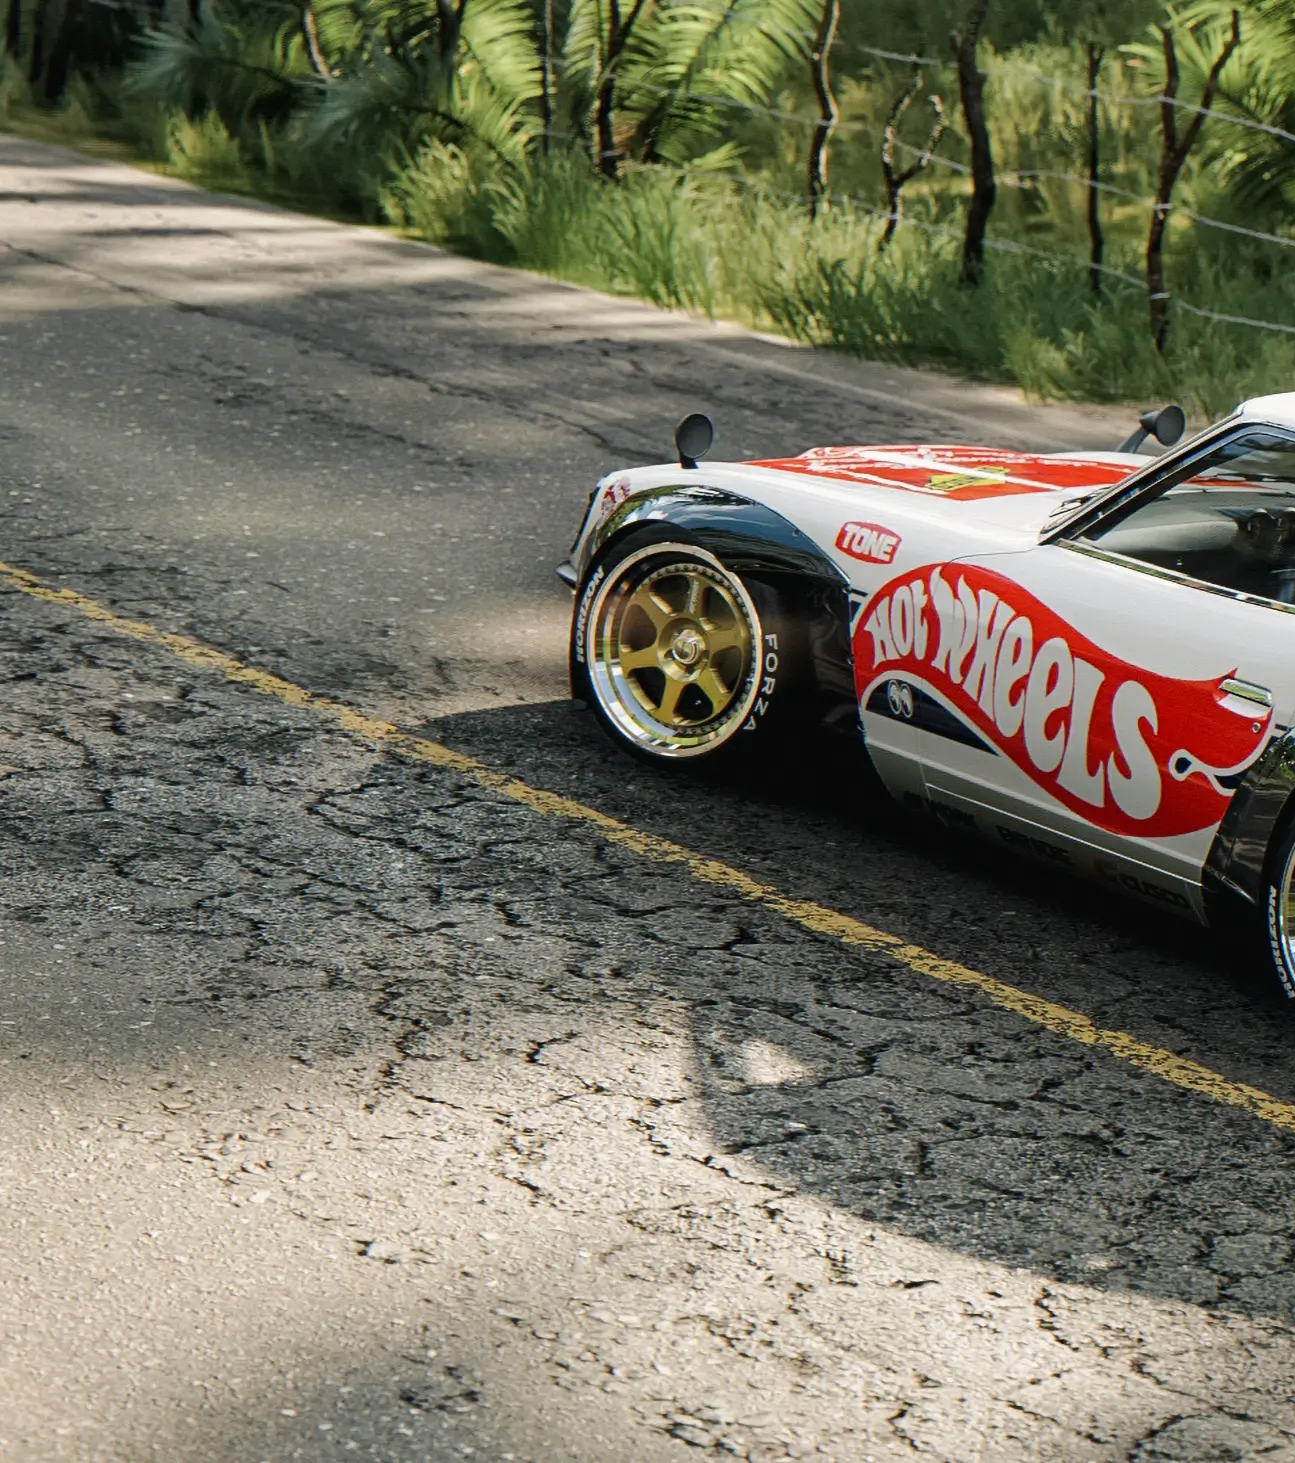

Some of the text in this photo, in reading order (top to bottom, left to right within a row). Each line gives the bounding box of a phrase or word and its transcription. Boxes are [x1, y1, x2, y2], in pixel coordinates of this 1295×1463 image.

[842, 524, 898, 562] TONE
[575, 564, 605, 663] HORIZON
[742, 633, 779, 731] FORZA
